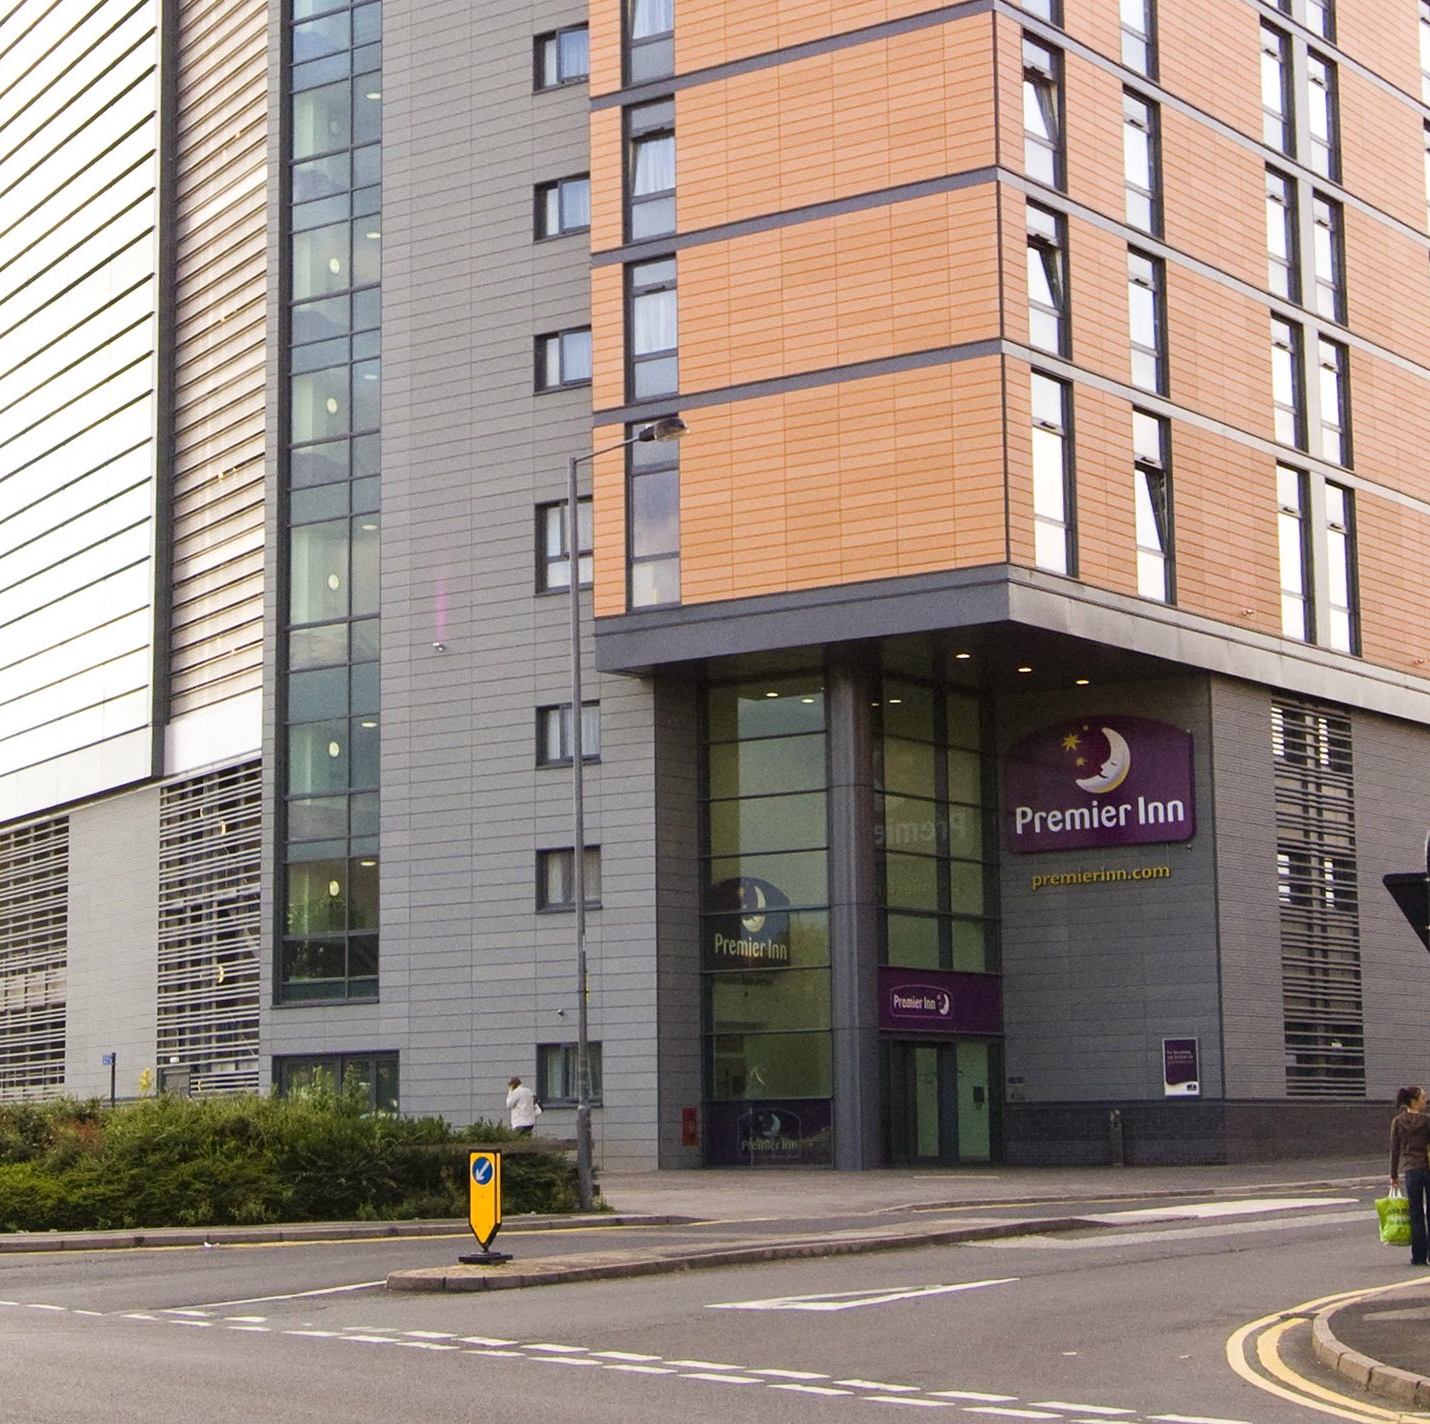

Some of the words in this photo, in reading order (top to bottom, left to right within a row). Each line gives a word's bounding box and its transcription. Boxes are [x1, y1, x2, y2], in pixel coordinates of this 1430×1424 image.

[1015, 800, 1132, 835] Premier
[1138, 796, 1184, 825] Inn
[1032, 865, 1171, 891] premierinn.com
[714, 933, 766, 957] Premier
[768, 939, 787, 960] Inn
[893, 994, 923, 1009] Premier
[924, 996, 936, 1010] Inn
